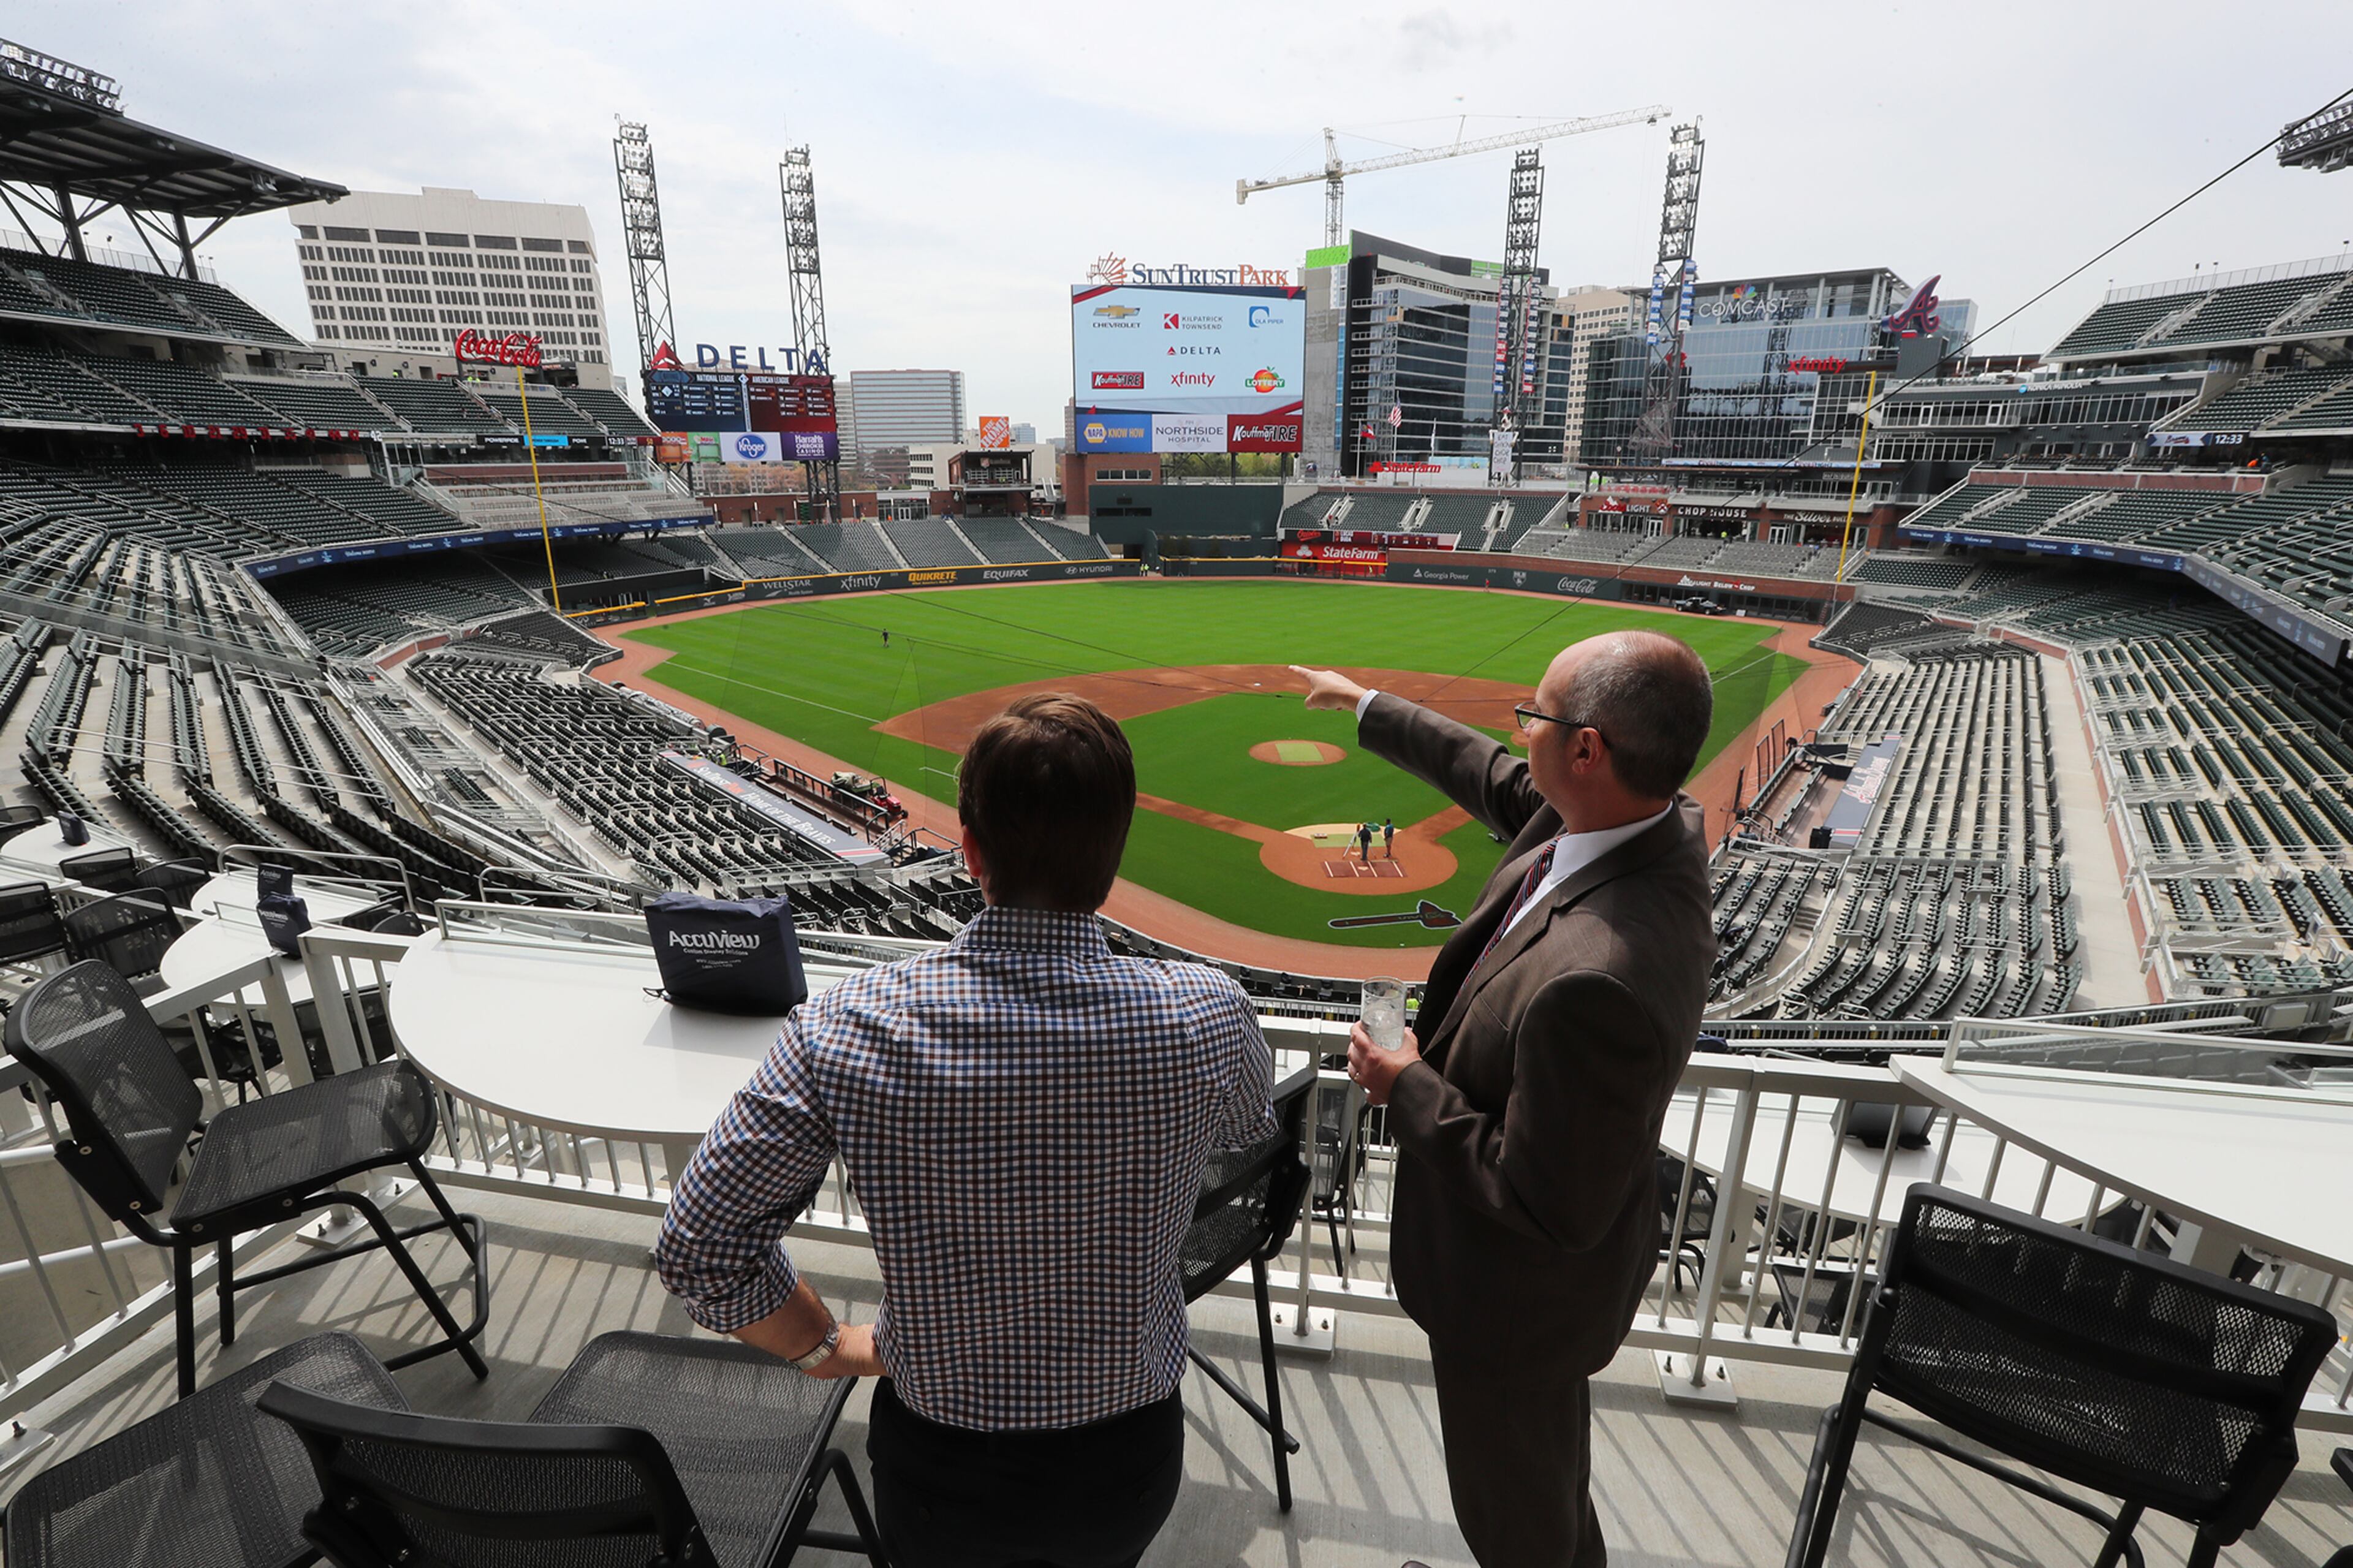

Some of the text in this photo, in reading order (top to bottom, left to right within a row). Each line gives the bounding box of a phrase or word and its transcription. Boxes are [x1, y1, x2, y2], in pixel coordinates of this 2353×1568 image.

[1699, 298, 1792, 317] COMCAST
[1180, 346, 1221, 355] DELTA
[697, 344, 827, 376] DELTA
[1787, 355, 1847, 375] xfinity
[1118, 374, 1141, 387] TIRE
[1170, 371, 1216, 388] xfinity
[1247, 378, 1284, 387] LOTTERY
[1088, 428, 1144, 437] NAPA KNOW HOW
[1156, 426, 1224, 435] NORTHSIDE
[1265, 425, 1298, 442] TIRE
[738, 434, 765, 457] Kroger
[2215, 434, 2244, 445] 12:33
[1678, 506, 1707, 515] CHOP
[1795, 511, 1832, 523] Silver
[908, 571, 957, 581] QUIKRETE
[983, 569, 1029, 581] EQUIFAX
[1423, 570, 1449, 580] Georgia
[762, 579, 811, 589] WELLSTAR
[840, 575, 881, 591] xfinity
[793, 820, 836, 845] BRAVES
